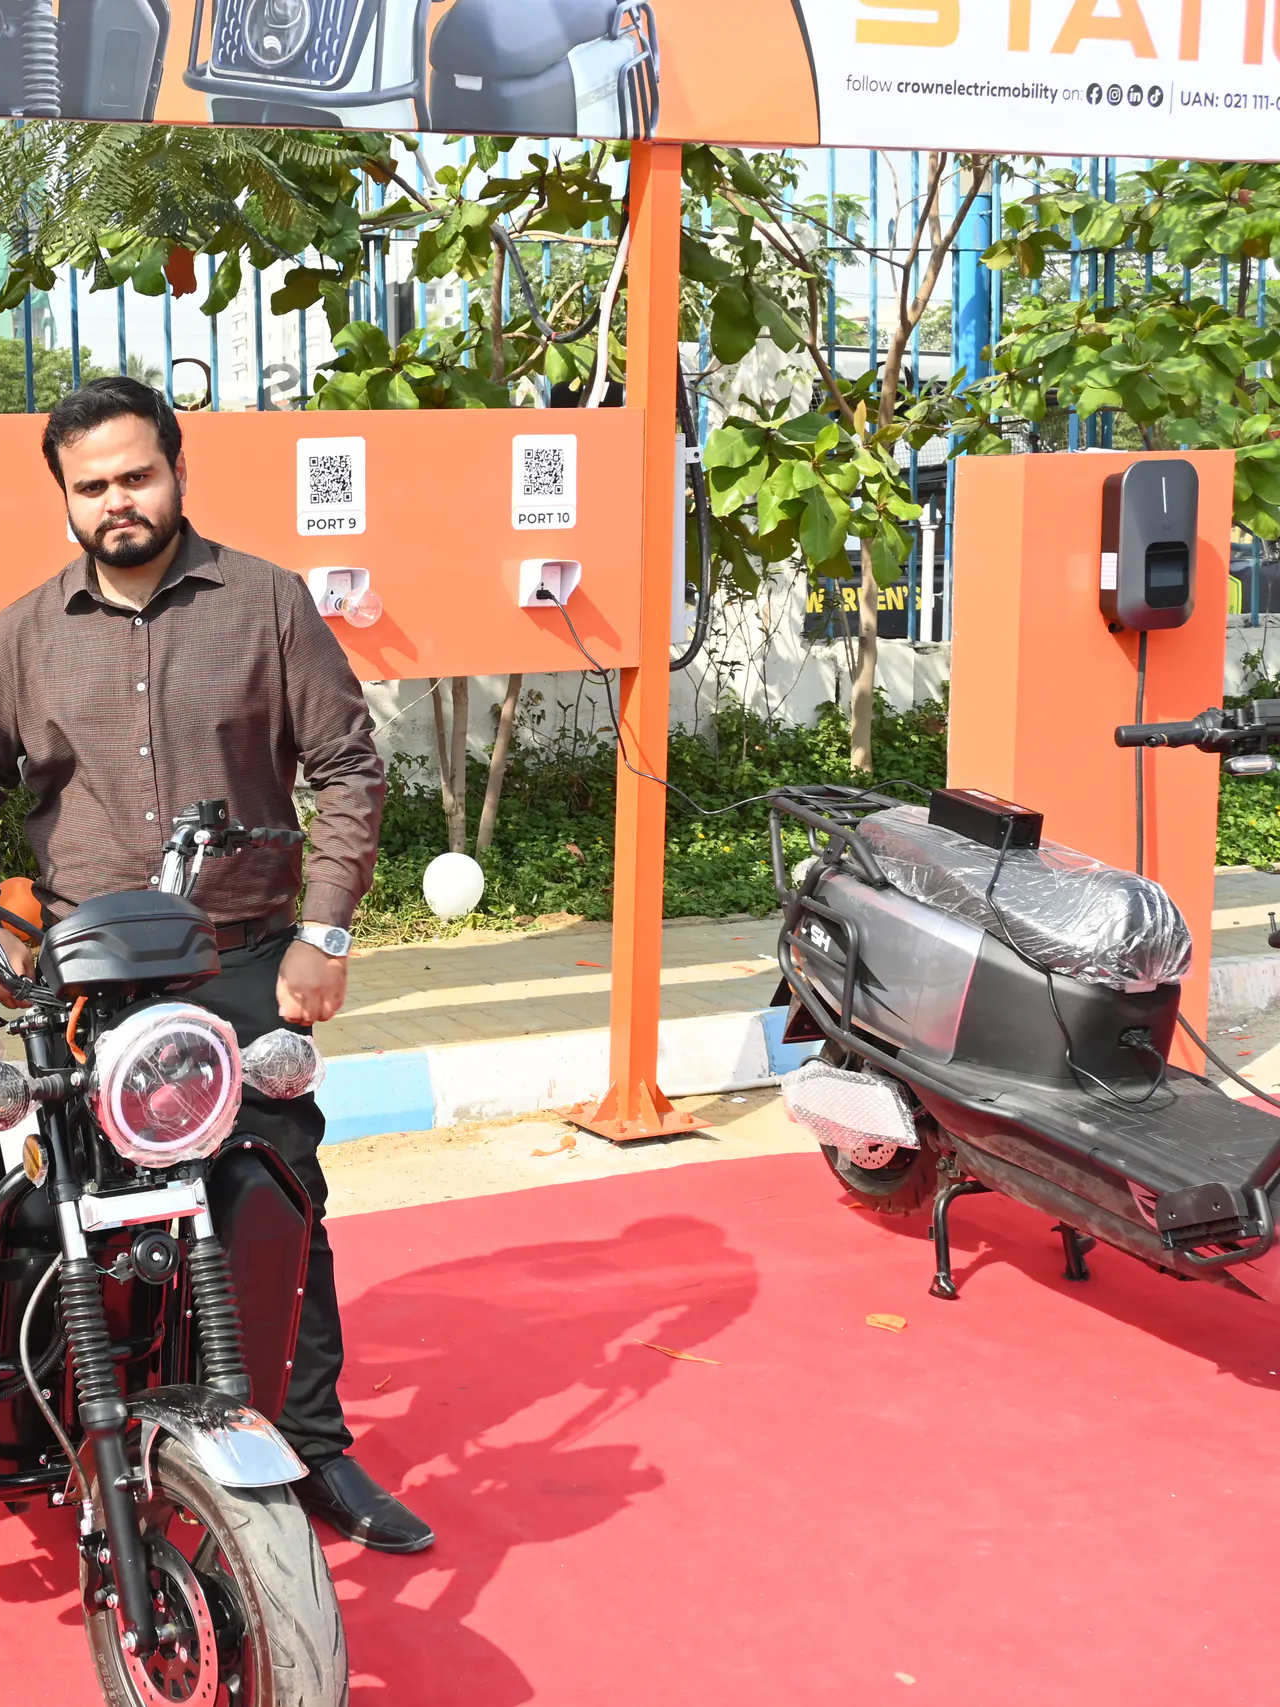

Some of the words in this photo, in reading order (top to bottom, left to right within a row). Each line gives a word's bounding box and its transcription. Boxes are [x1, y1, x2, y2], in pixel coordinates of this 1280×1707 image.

[846, 74, 893, 92] follow
[896, 79, 1059, 105] crownelectricmobility
[1062, 88, 1083, 101] on:
[1180, 90, 1219, 108] UAN:
[1223, 92, 1248, 109] 021
[307, 517, 345, 531] PORT
[348, 517, 357, 529] 9
[518, 512, 554, 525] PORT
[556, 512, 570, 523] 10
